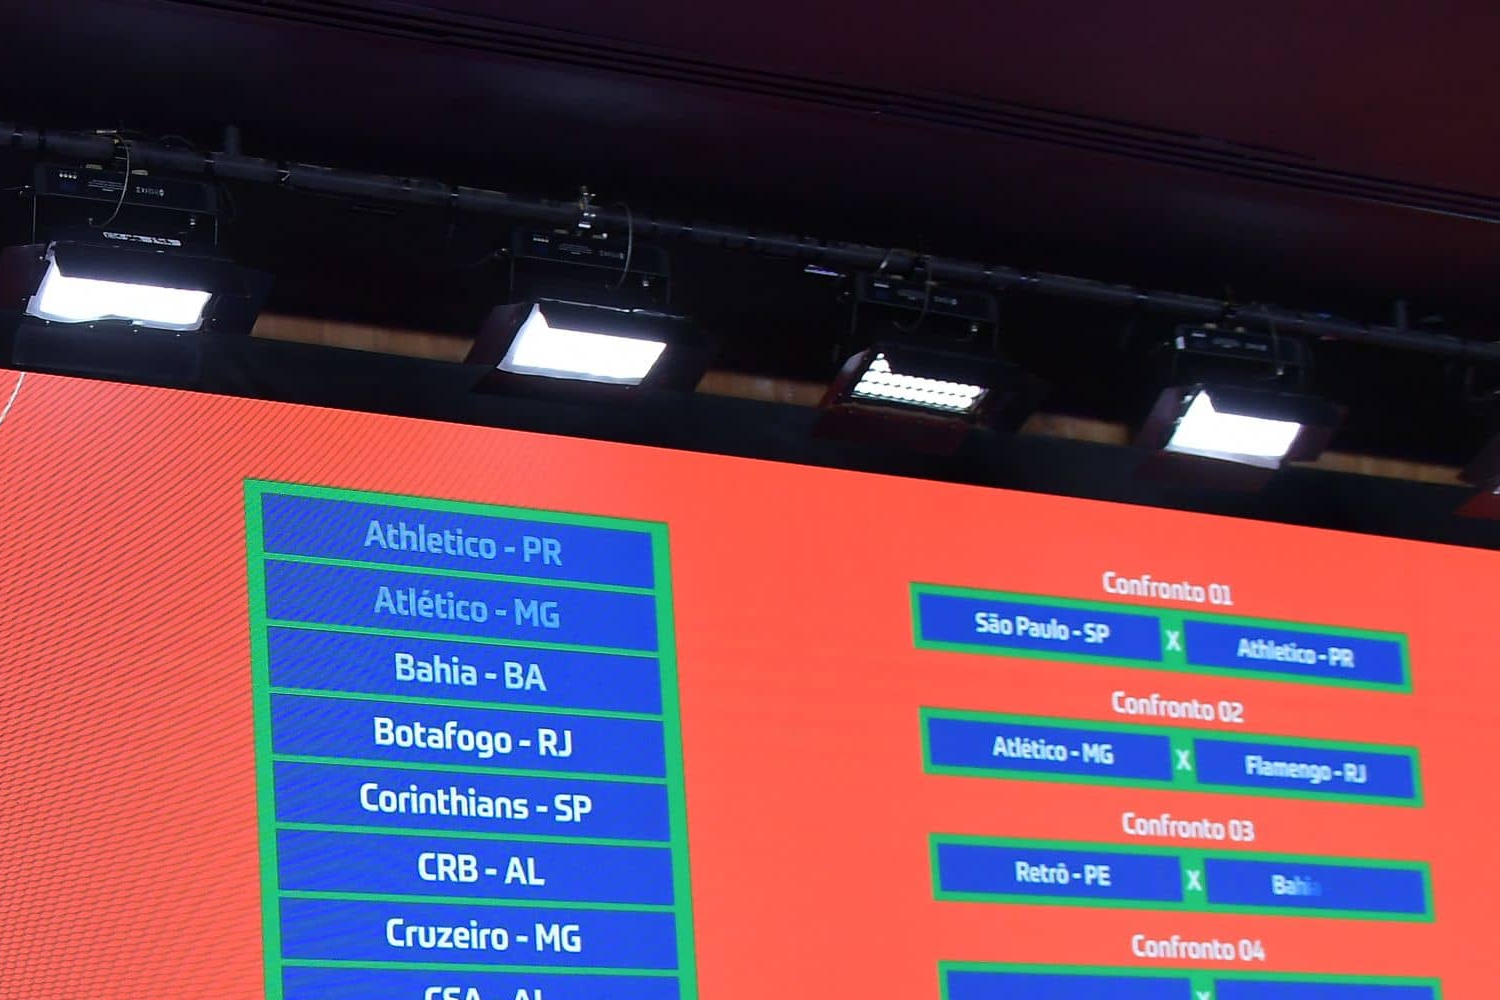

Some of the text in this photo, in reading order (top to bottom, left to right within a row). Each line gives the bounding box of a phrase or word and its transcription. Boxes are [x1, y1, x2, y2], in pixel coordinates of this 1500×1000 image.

[364, 519, 497, 560] Athletico
[522, 536, 563, 566] PR
[1102, 571, 1233, 606] Confronto 01
[373, 586, 488, 623] Atlético
[514, 598, 560, 629] MG
[975, 612, 1013, 637] São
[1015, 616, 1070, 642] Paulo
[1083, 623, 1110, 645] SP
[1237, 638, 1316, 666] Athletico
[1328, 648, 1355, 669] PR
[394, 653, 477, 686] Bahia
[504, 661, 547, 692] BA
[1112, 691, 1244, 723] Confronto 02
[373, 716, 512, 759] Botafogo
[538, 728, 573, 758] RJ
[993, 735, 1067, 763] Atlético
[1082, 742, 1114, 766] MG
[1245, 755, 1332, 785] Flamengo
[1343, 763, 1367, 784] RJ
[359, 782, 529, 820] Corinthians
[554, 793, 593, 823] SP
[1122, 812, 1255, 842] Confronto 03
[418, 852, 478, 883] CRB
[504, 856, 545, 886] AL
[1014, 861, 1070, 885] Retrô
[1084, 865, 1112, 887] PE
[385, 917, 509, 951] Cruzeiro
[535, 923, 582, 953] MG
[1132, 934, 1266, 962] Confronto 04
